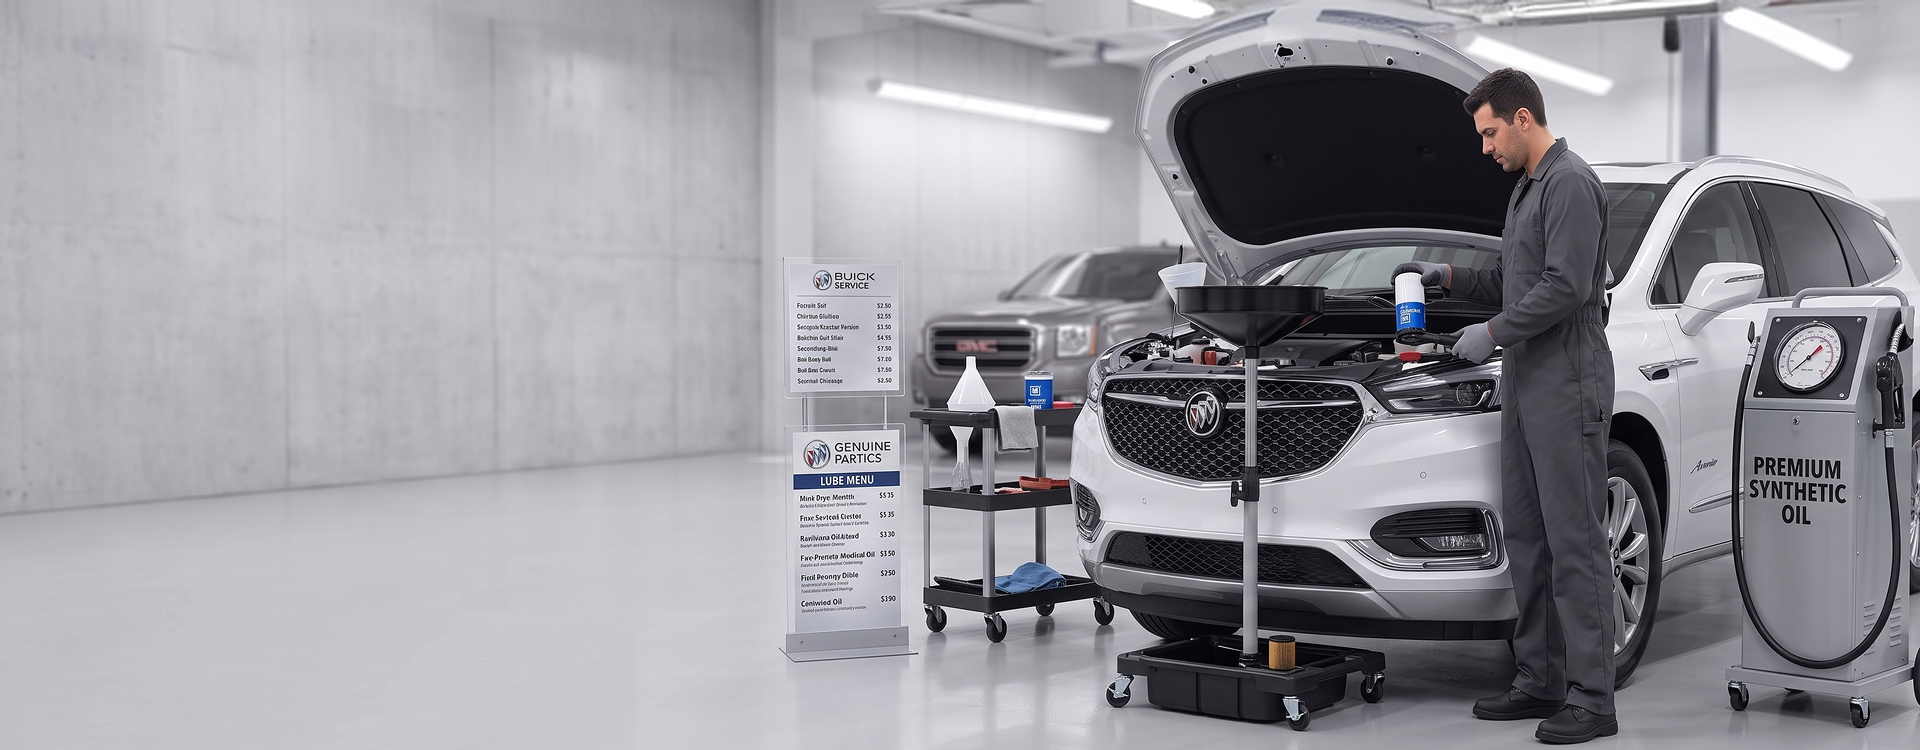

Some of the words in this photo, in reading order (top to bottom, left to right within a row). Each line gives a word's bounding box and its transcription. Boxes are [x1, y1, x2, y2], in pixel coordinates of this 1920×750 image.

[834, 272, 875, 281] BUICK
[834, 441, 891, 453] GENUINE
[834, 453, 882, 464] PARTICS
[1753, 456, 1842, 480] PREMIUM
[820, 476, 844, 486] LUBE
[846, 475, 875, 485] MENU
[1749, 479, 1847, 504] SYNTHETIC
[1781, 504, 1812, 526] OIL
